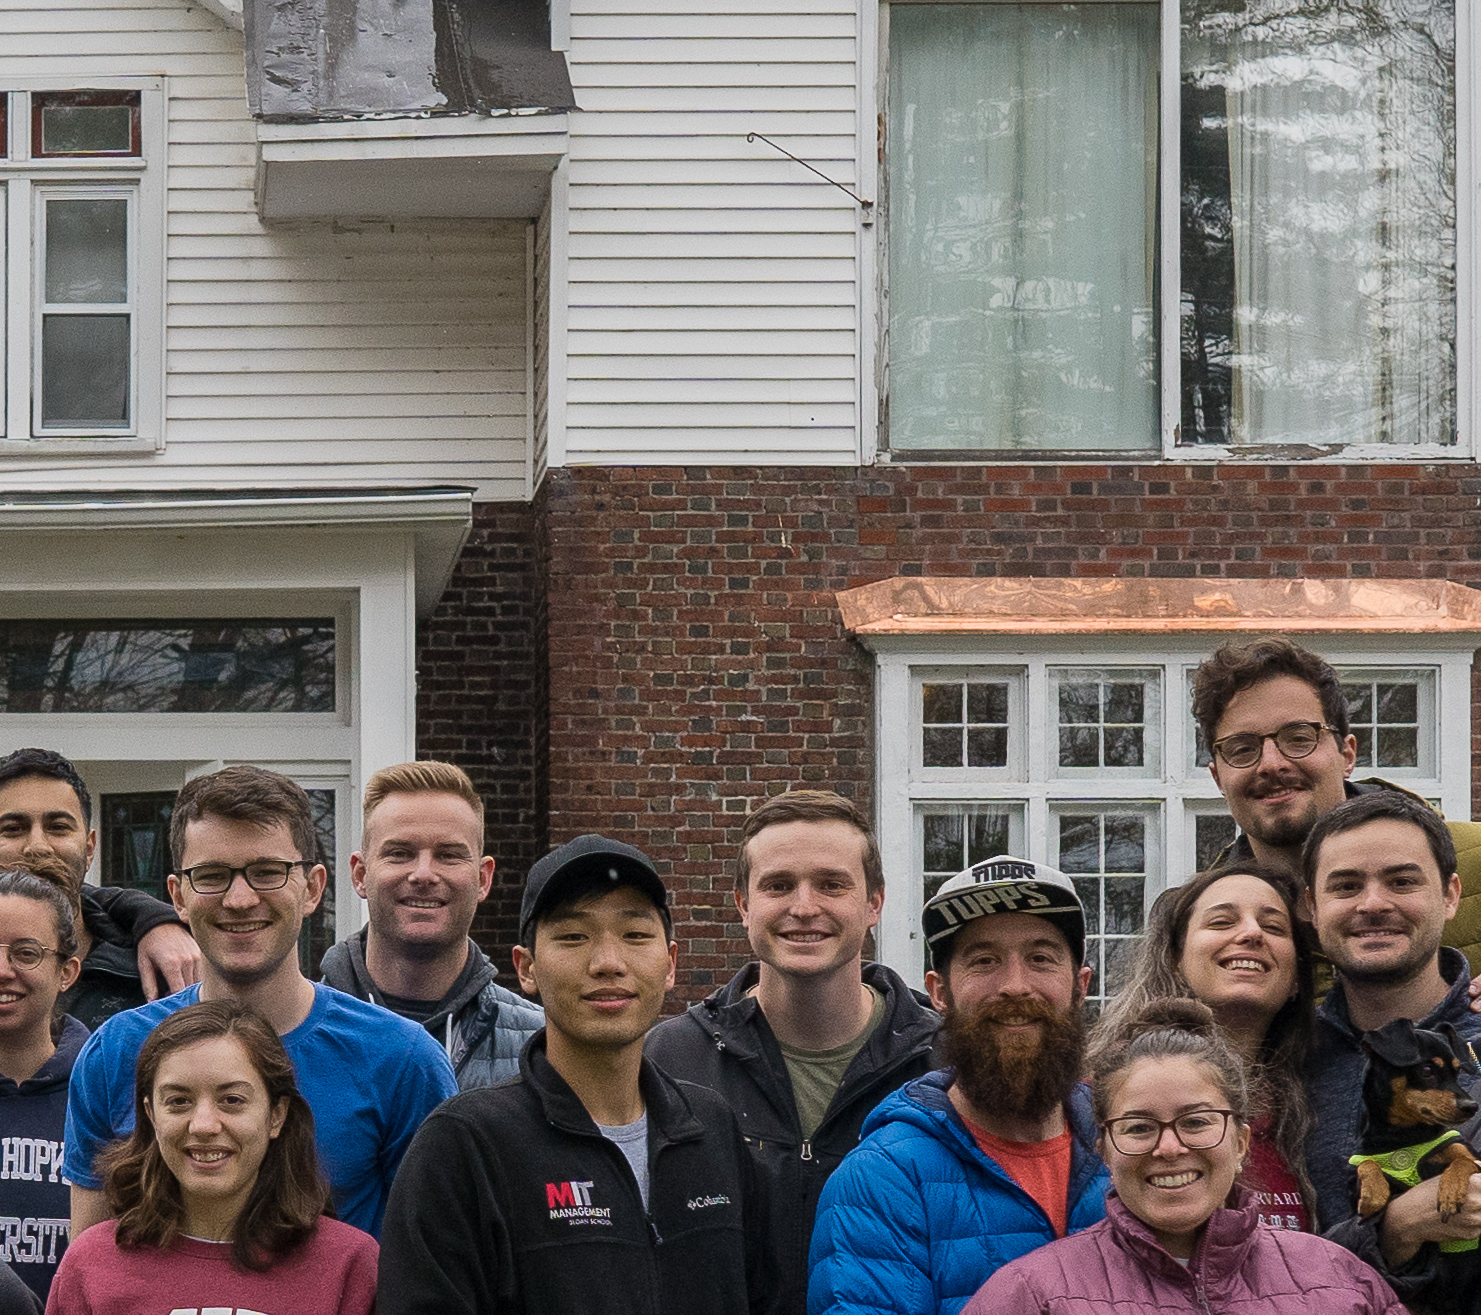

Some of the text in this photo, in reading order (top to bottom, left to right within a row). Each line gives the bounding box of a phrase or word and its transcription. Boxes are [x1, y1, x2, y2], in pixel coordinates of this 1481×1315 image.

[930, 884, 1051, 926] TUPPS
[545, 1180, 595, 1209] MIT
[549, 1206, 611, 1220] MANAGEMENT
